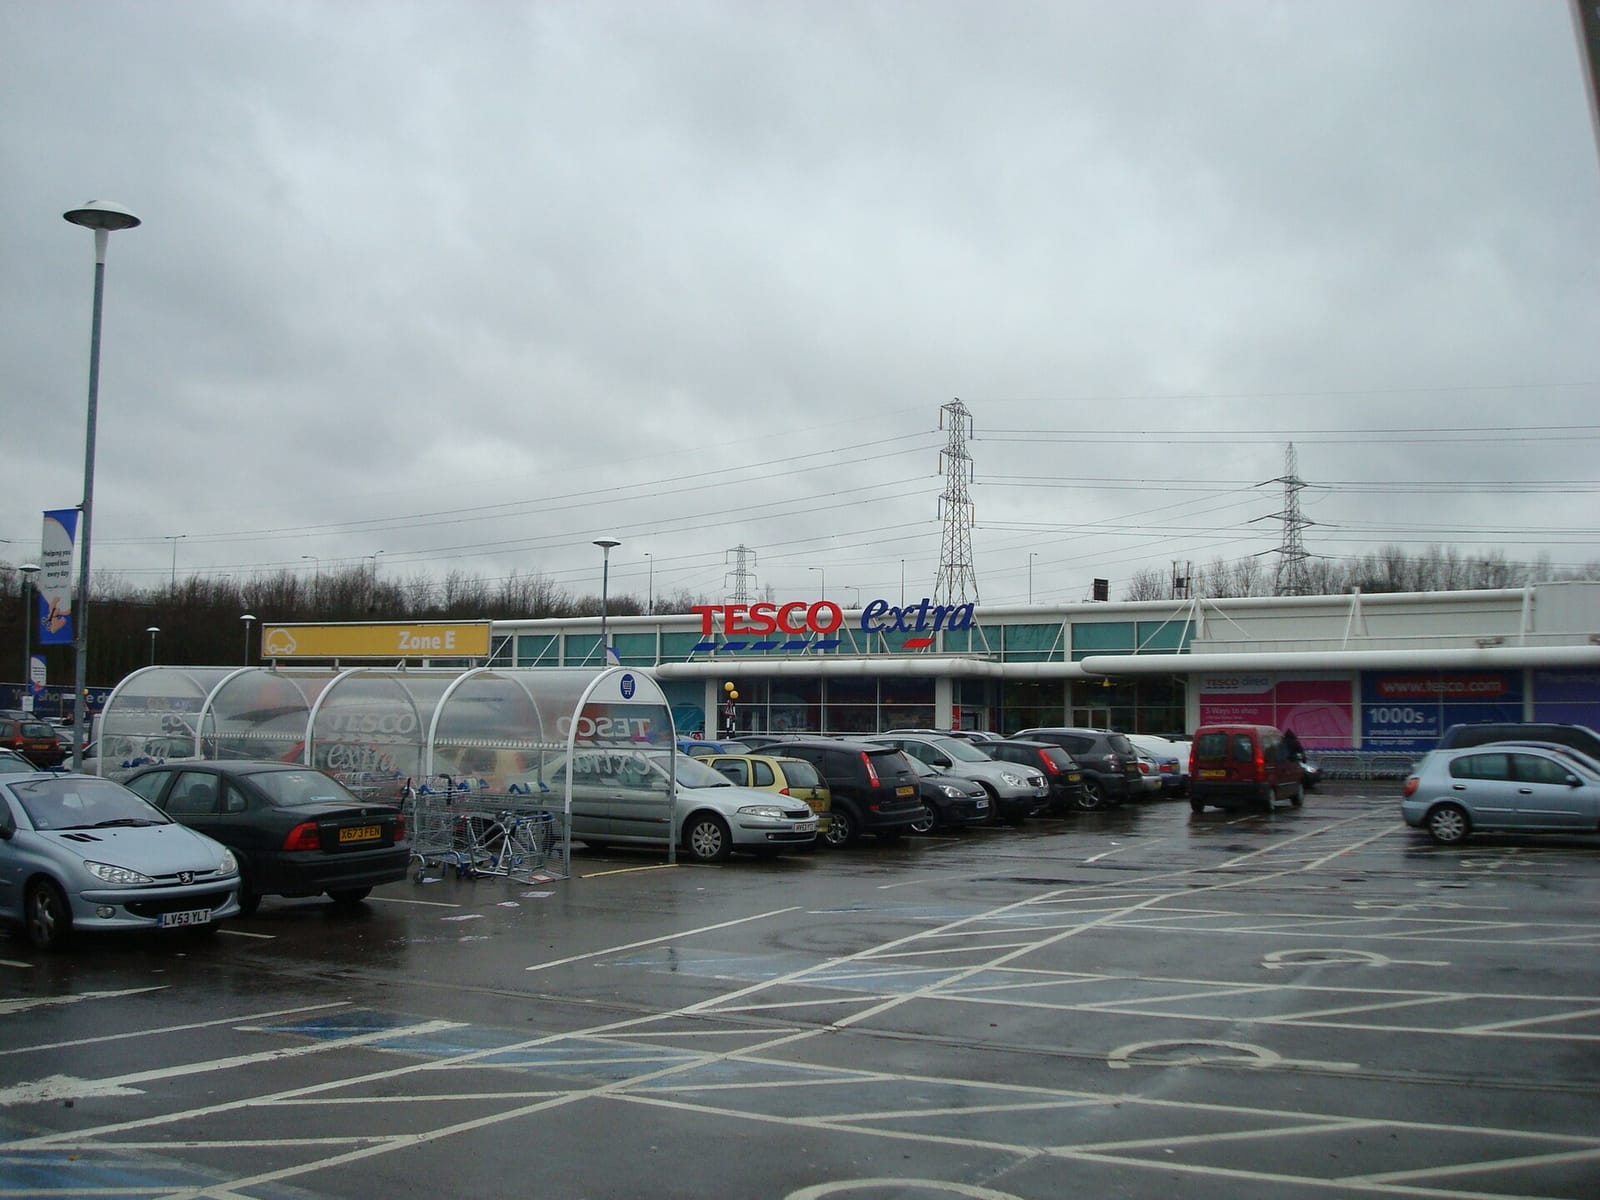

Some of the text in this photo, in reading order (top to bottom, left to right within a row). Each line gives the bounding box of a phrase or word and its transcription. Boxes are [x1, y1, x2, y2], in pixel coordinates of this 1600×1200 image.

[692, 598, 976, 636] TESCO extra
[399, 631, 456, 650] Zone E
[1206, 679, 1239, 687] TESCO
[1383, 680, 1501, 693] www.tesco.com
[329, 713, 417, 734] TESCO
[1369, 707, 1424, 724] 1000s
[327, 743, 398, 772] extra
[342, 826, 380, 840] X673 FEN
[192, 910, 208, 922] YLT
